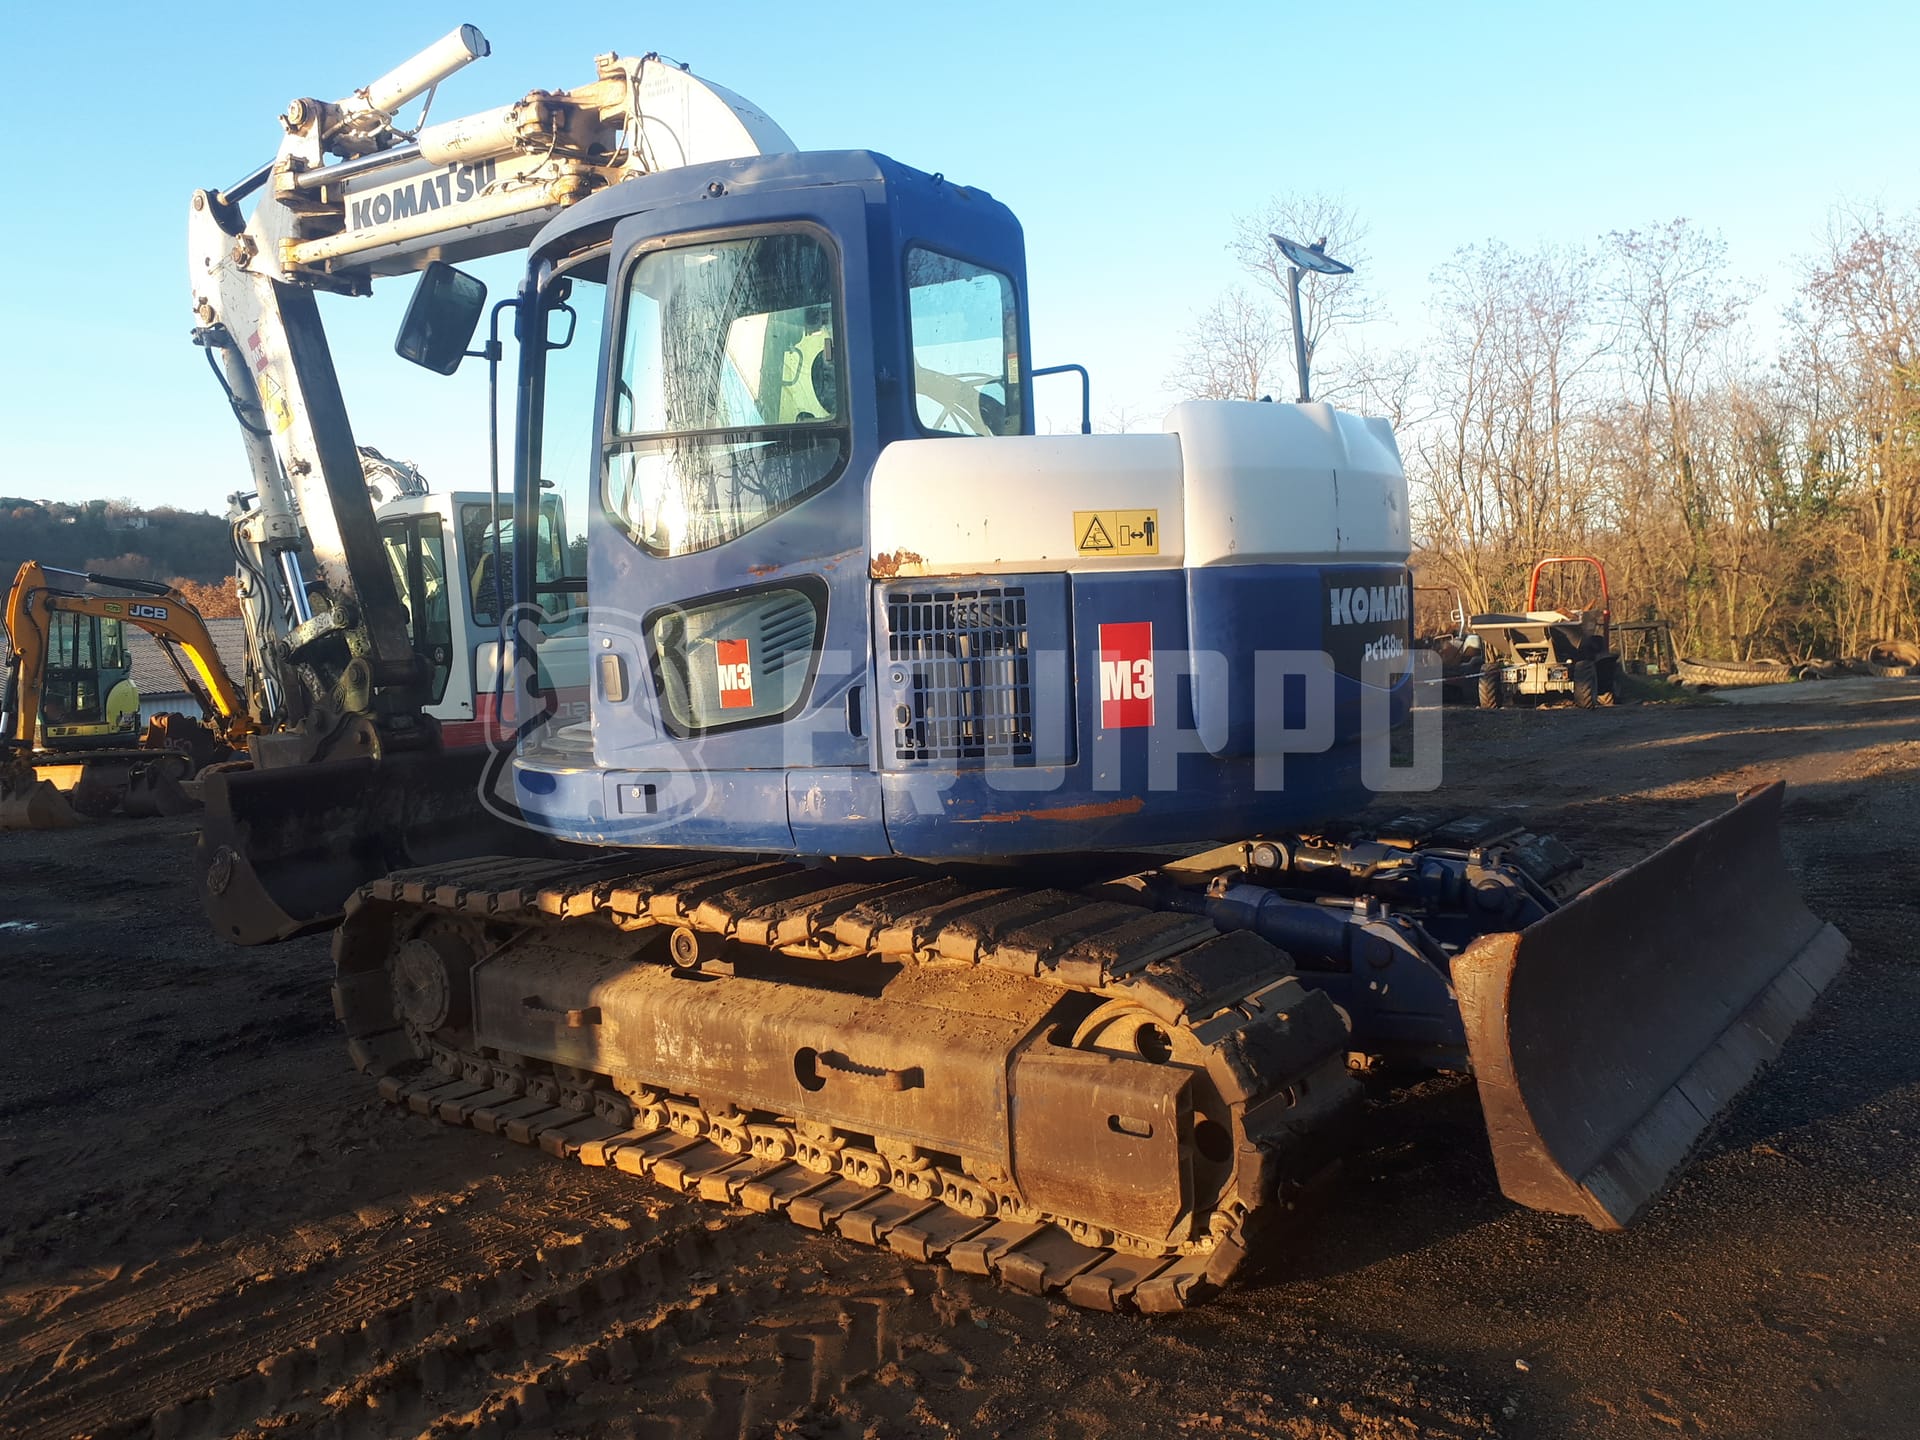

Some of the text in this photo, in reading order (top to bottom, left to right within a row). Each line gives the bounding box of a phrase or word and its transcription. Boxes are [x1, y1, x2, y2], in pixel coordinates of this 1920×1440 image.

[351, 157, 496, 231] KOMATSU
[130, 604, 167, 620] JCB
[717, 663, 751, 691] M3
[1101, 659, 1153, 701] M3
